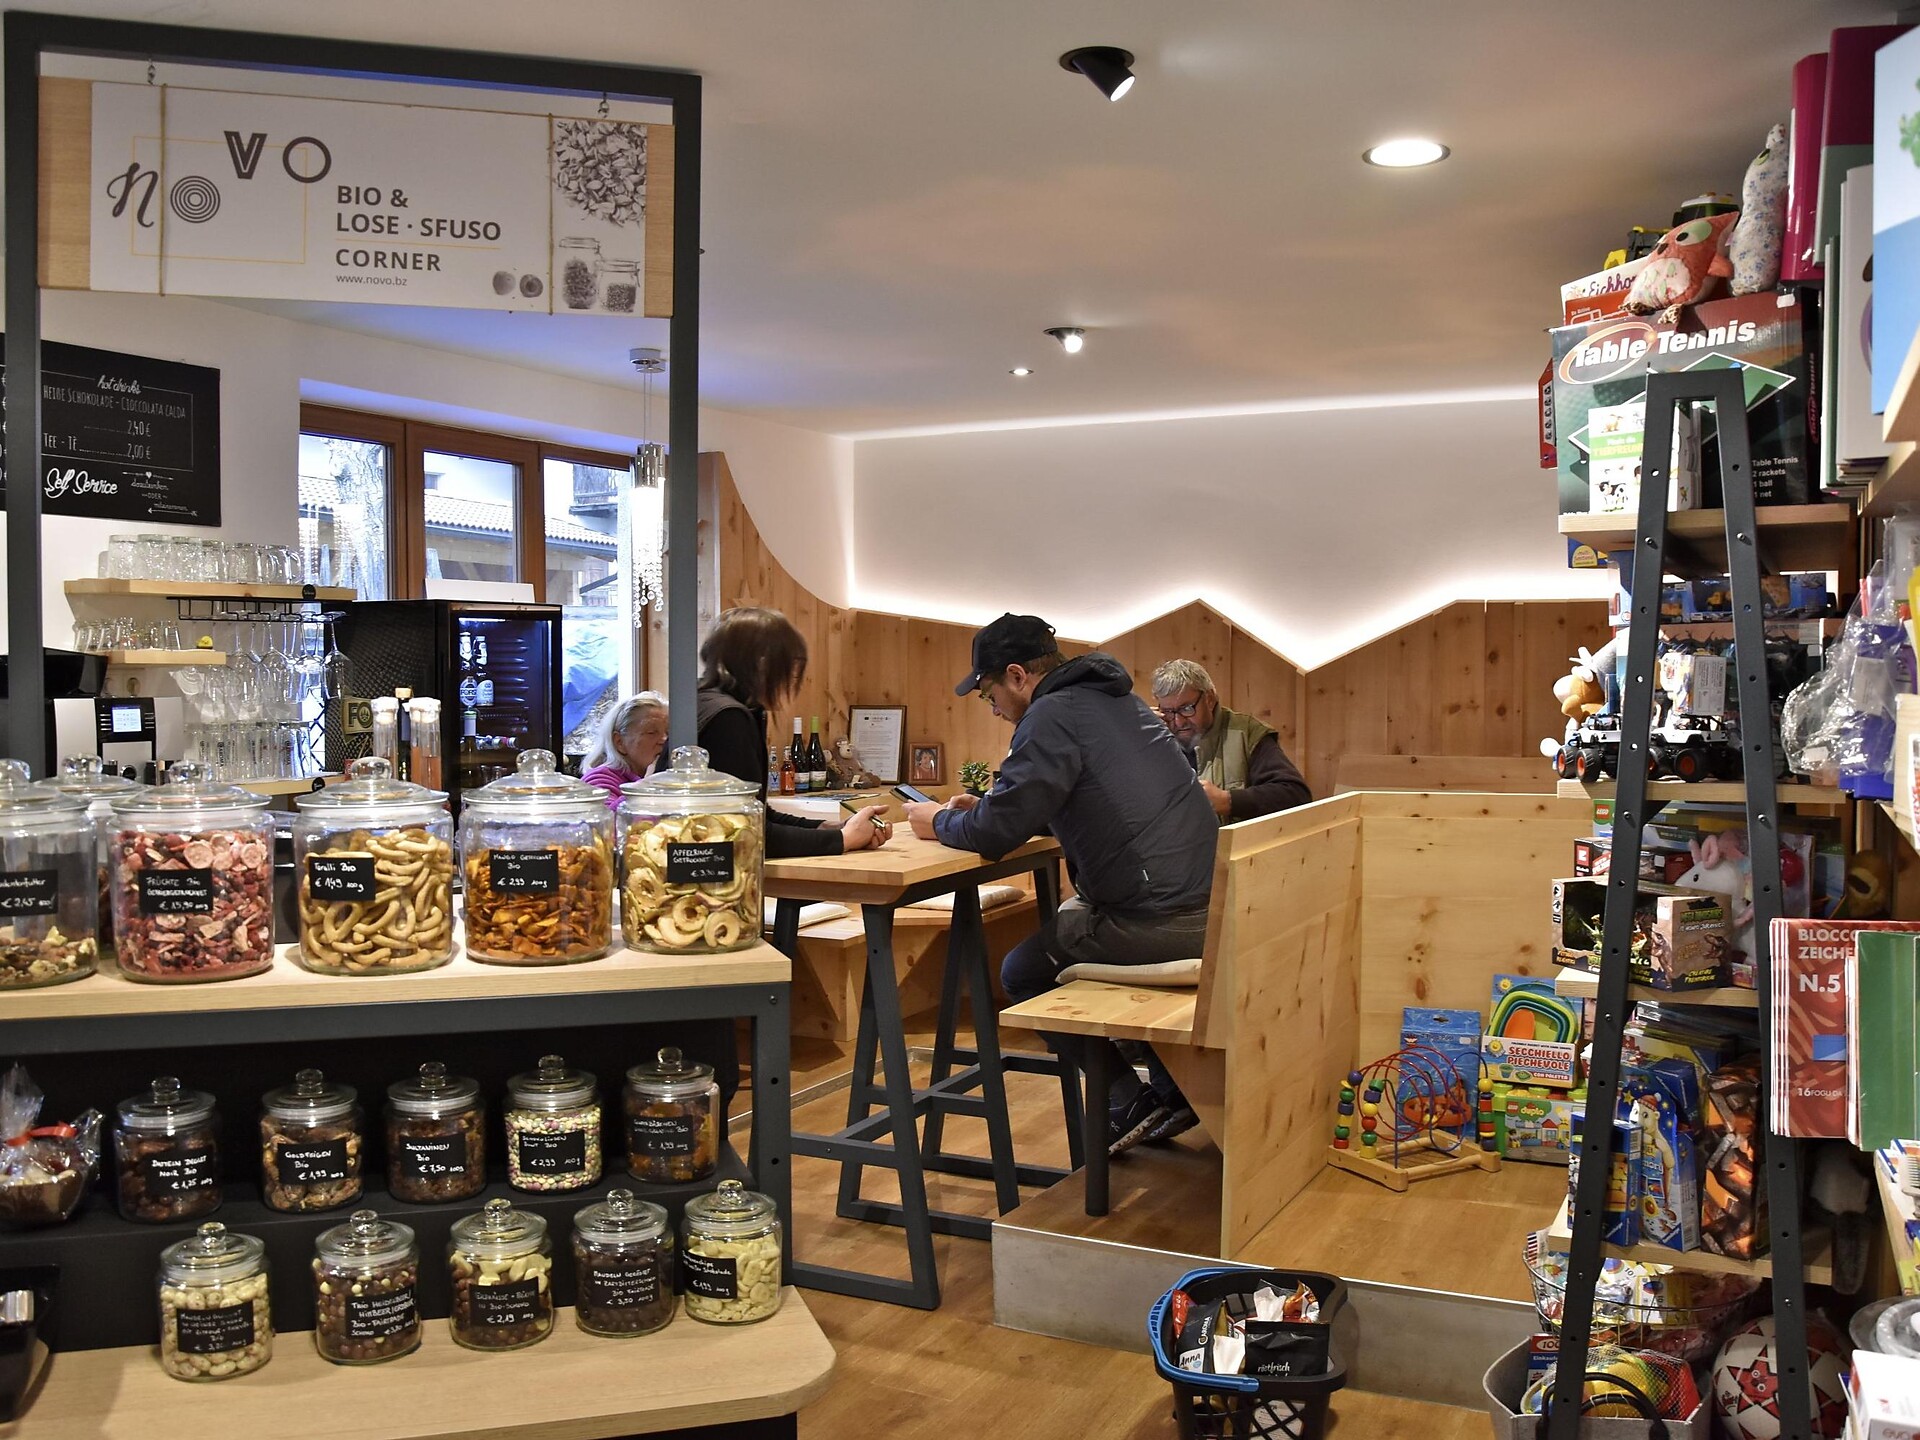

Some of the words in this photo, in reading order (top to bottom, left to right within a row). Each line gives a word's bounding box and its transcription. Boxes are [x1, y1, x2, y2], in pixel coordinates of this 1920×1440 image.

[337, 185, 381, 206] BIO
[390, 189, 408, 208] &
[337, 212, 399, 235] LOSE
[420, 218, 501, 241] SFUSO
[336, 249, 441, 271] CORNER
[336, 275, 408, 286] www.novo.bz
[1574, 337, 1647, 368] Table
[1656, 319, 1756, 354] Tennis
[97, 374, 115, 390] hot
[43, 432, 57, 449] TEE
[1752, 459, 1772, 467] Table
[1774, 456, 1799, 466] Tennis
[1758, 468, 1786, 478] rackets
[44, 467, 76, 499] Self
[73, 470, 118, 495] Service
[1759, 480, 1773, 488] ball
[314, 877, 322, 888] €
[324, 876, 343, 890] 1,49
[346, 881, 365, 893] 100g
[497, 877, 507, 886] €
[1798, 946, 1854, 959] ZEICHE
[1799, 974, 1841, 993] N.5
[1508, 1046, 1570, 1060] SECCHIELLO
[1520, 1106, 1545, 1117] duplo
[418, 1164, 429, 1173] €
[530, 1158, 537, 1166] €
[297, 1171, 307, 1180] €
[486, 1315, 496, 1324] €
[1180, 1353, 1201, 1367] Anna
